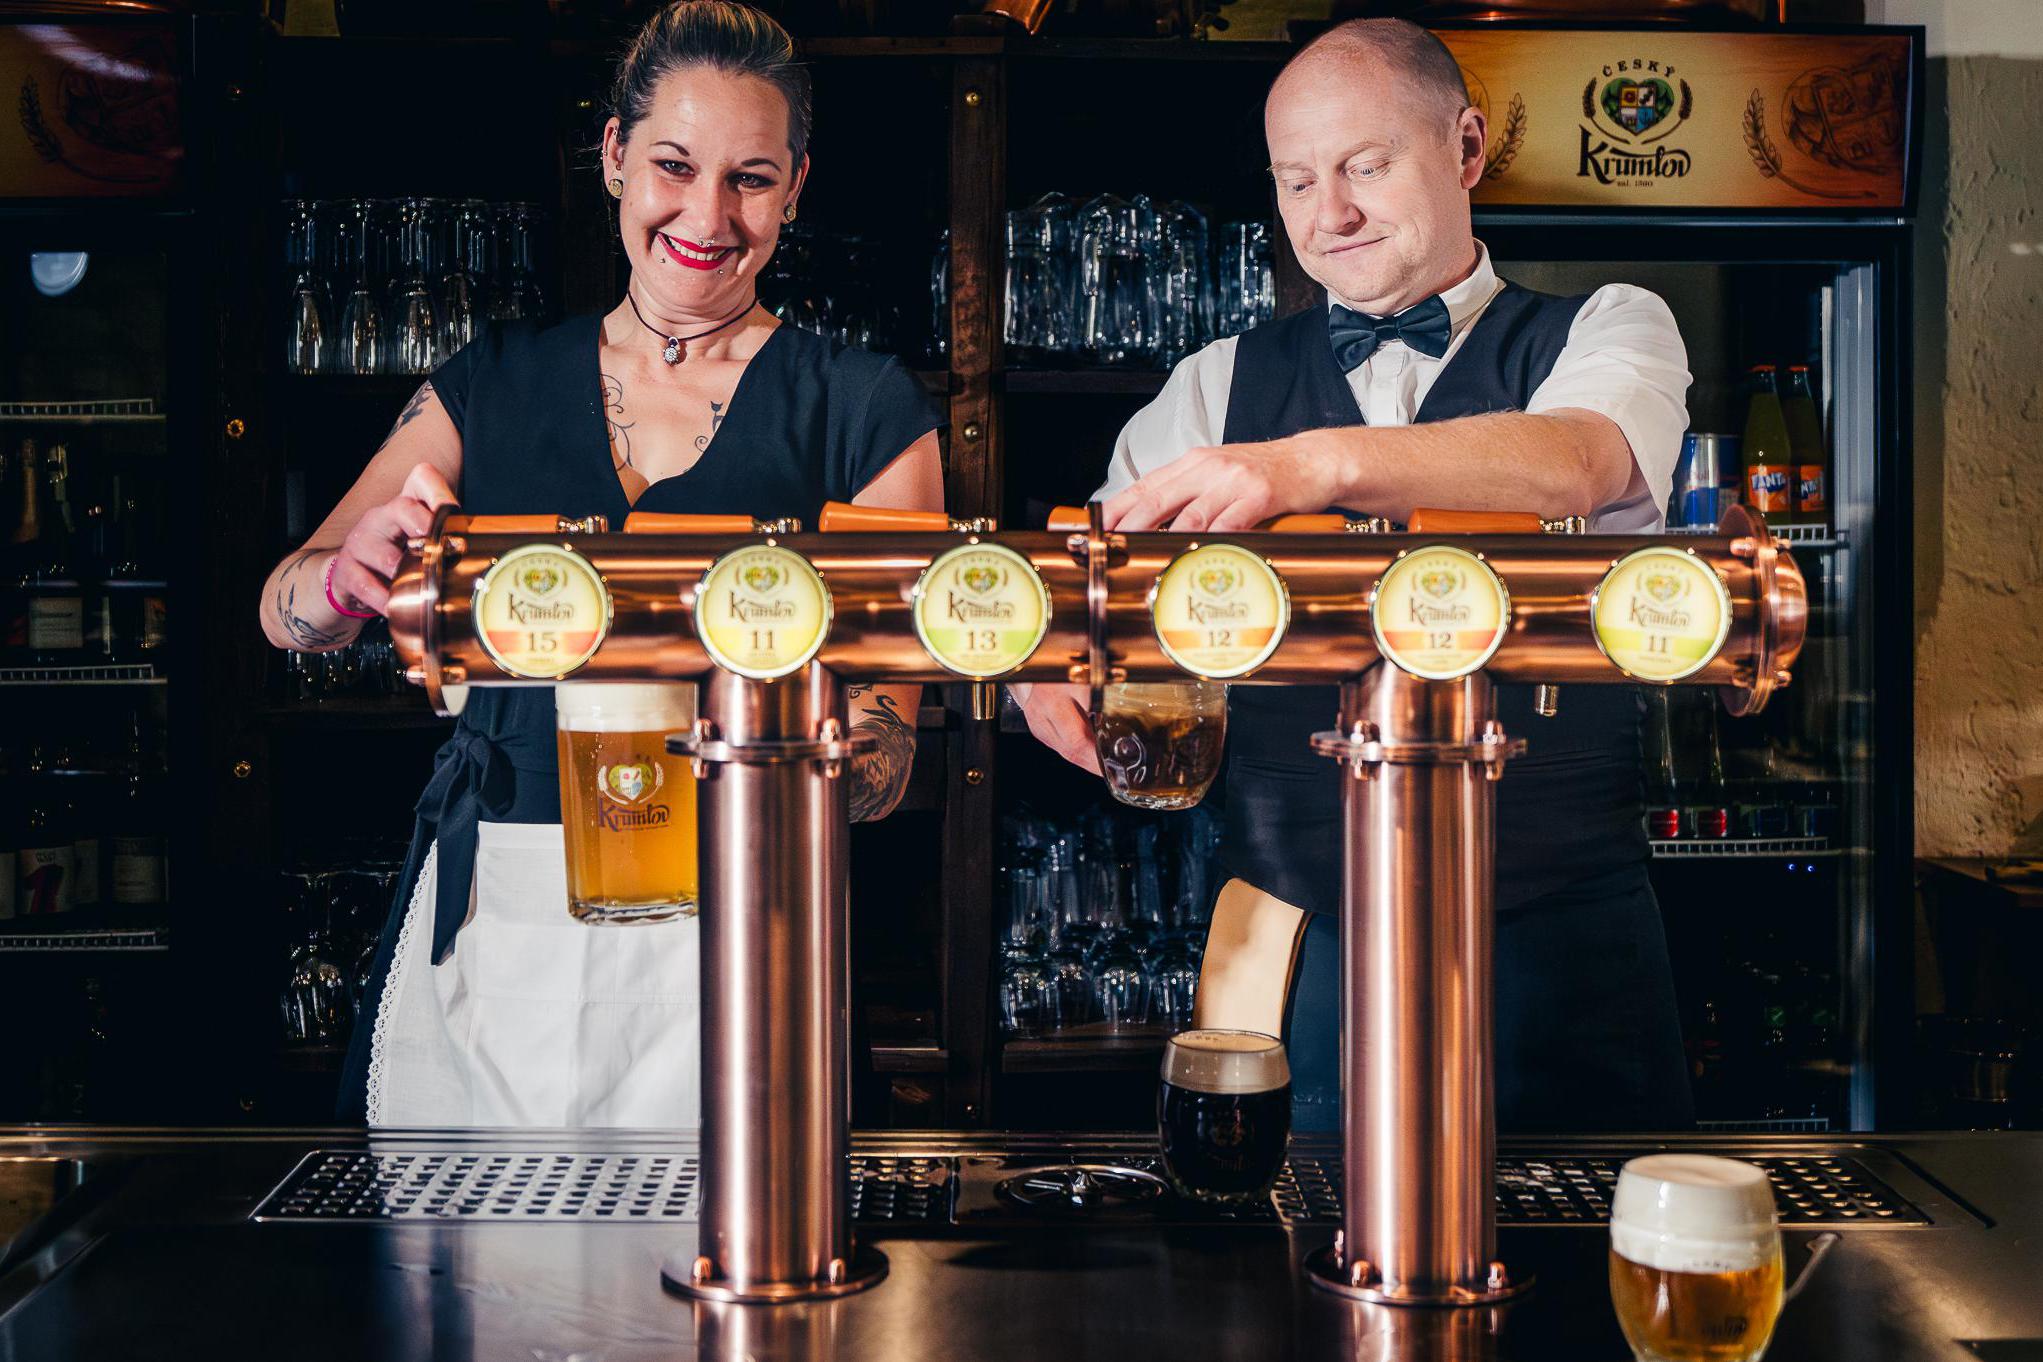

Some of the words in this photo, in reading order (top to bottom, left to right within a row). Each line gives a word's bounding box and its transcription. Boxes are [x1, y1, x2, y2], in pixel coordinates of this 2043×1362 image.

[1576, 124, 1692, 185] Krumlov
[508, 592, 575, 625] Krumlov
[728, 590, 795, 624] Krumlov
[946, 590, 1015, 624] Krumlov
[1409, 596, 1471, 627] Krumlov
[528, 631, 558, 653] 15
[751, 630, 774, 650] 11
[966, 630, 997, 651] 13
[1207, 629, 1232, 648] 12
[1428, 632, 1452, 649] 12
[1647, 634, 1668, 654] 11
[599, 800, 671, 832] Krumlov
